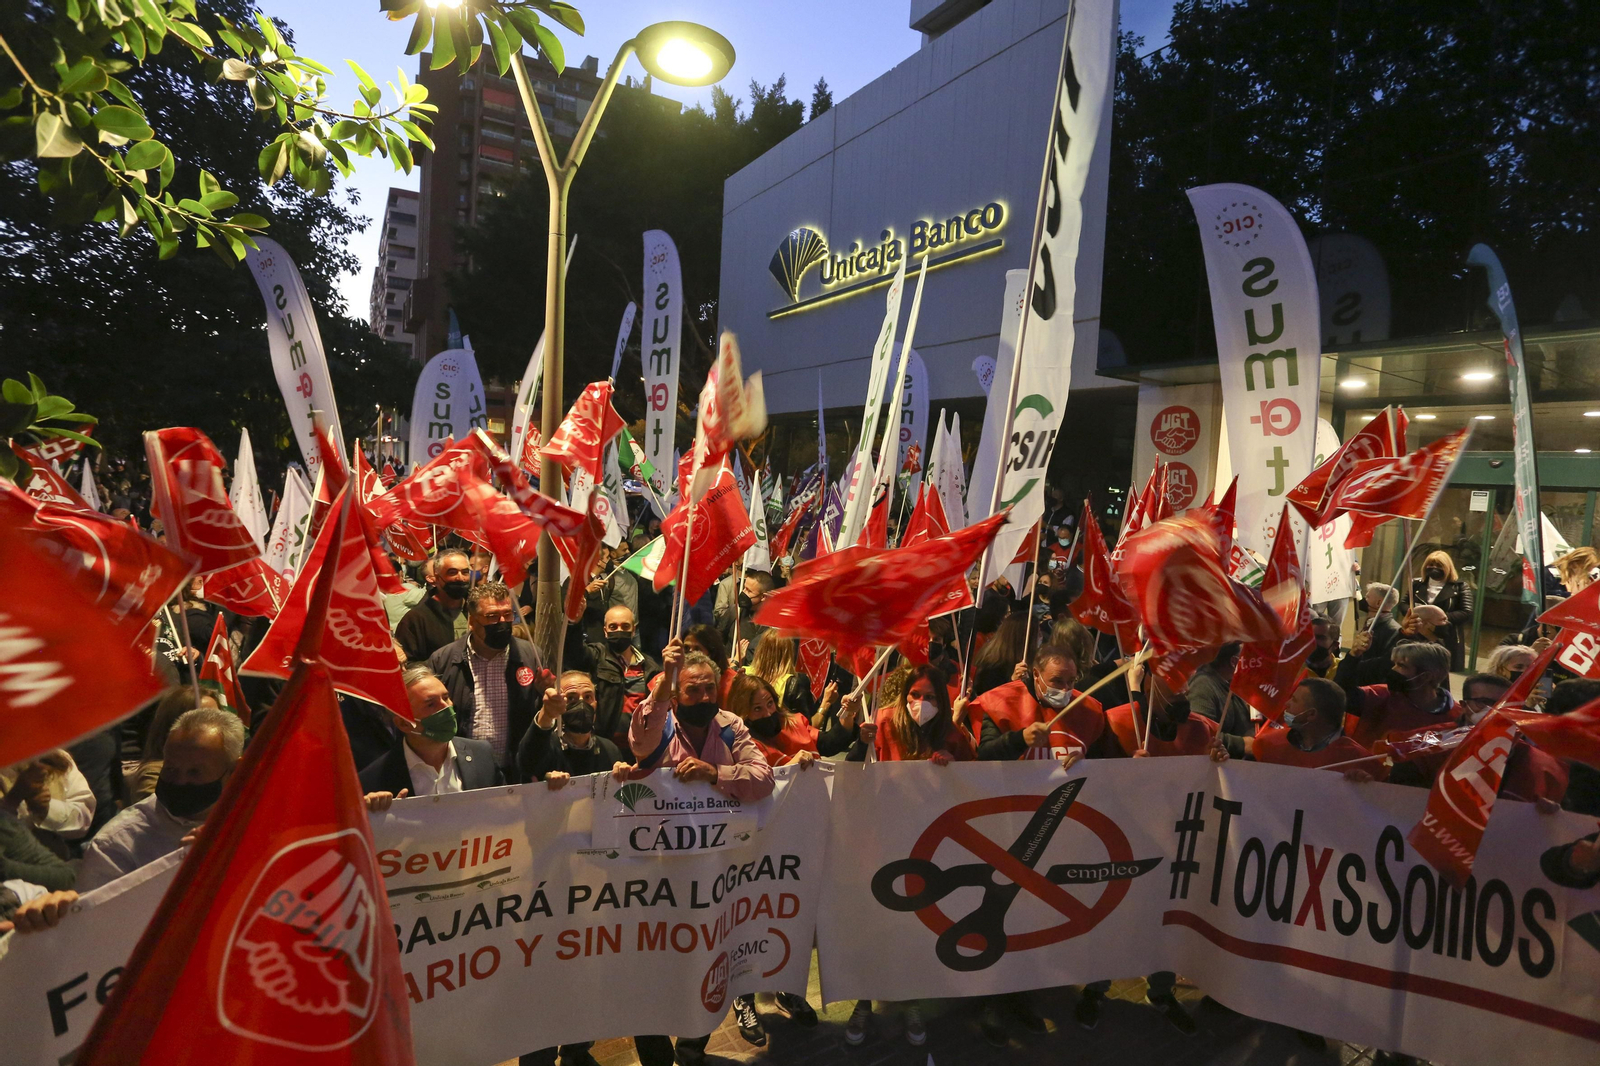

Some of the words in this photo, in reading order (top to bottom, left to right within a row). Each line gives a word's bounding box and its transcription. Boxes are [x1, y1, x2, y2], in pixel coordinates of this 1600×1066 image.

[819, 229, 905, 286] Unicaja
[908, 202, 1004, 255] Banco
[442, 364, 457, 372] CIC
[1160, 412, 1191, 431] UGT
[654, 797, 704, 812] Unicaja
[706, 797, 741, 809] Banco
[1022, 816, 1053, 863] condiciones
[1049, 783, 1077, 817] laborales
[629, 818, 728, 851] CÁDIZ
[375, 834, 514, 879] Sevilla
[1066, 862, 1140, 881] empleo
[429, 893, 450, 901] Unicaja
[567, 877, 677, 915] PARA
[690, 853, 801, 910] LOGRAR
[1169, 791, 1557, 980] #TodxsSomos
[515, 934, 544, 968] Y
[556, 924, 622, 961] SIN
[637, 891, 801, 953] MOVILIDAD
